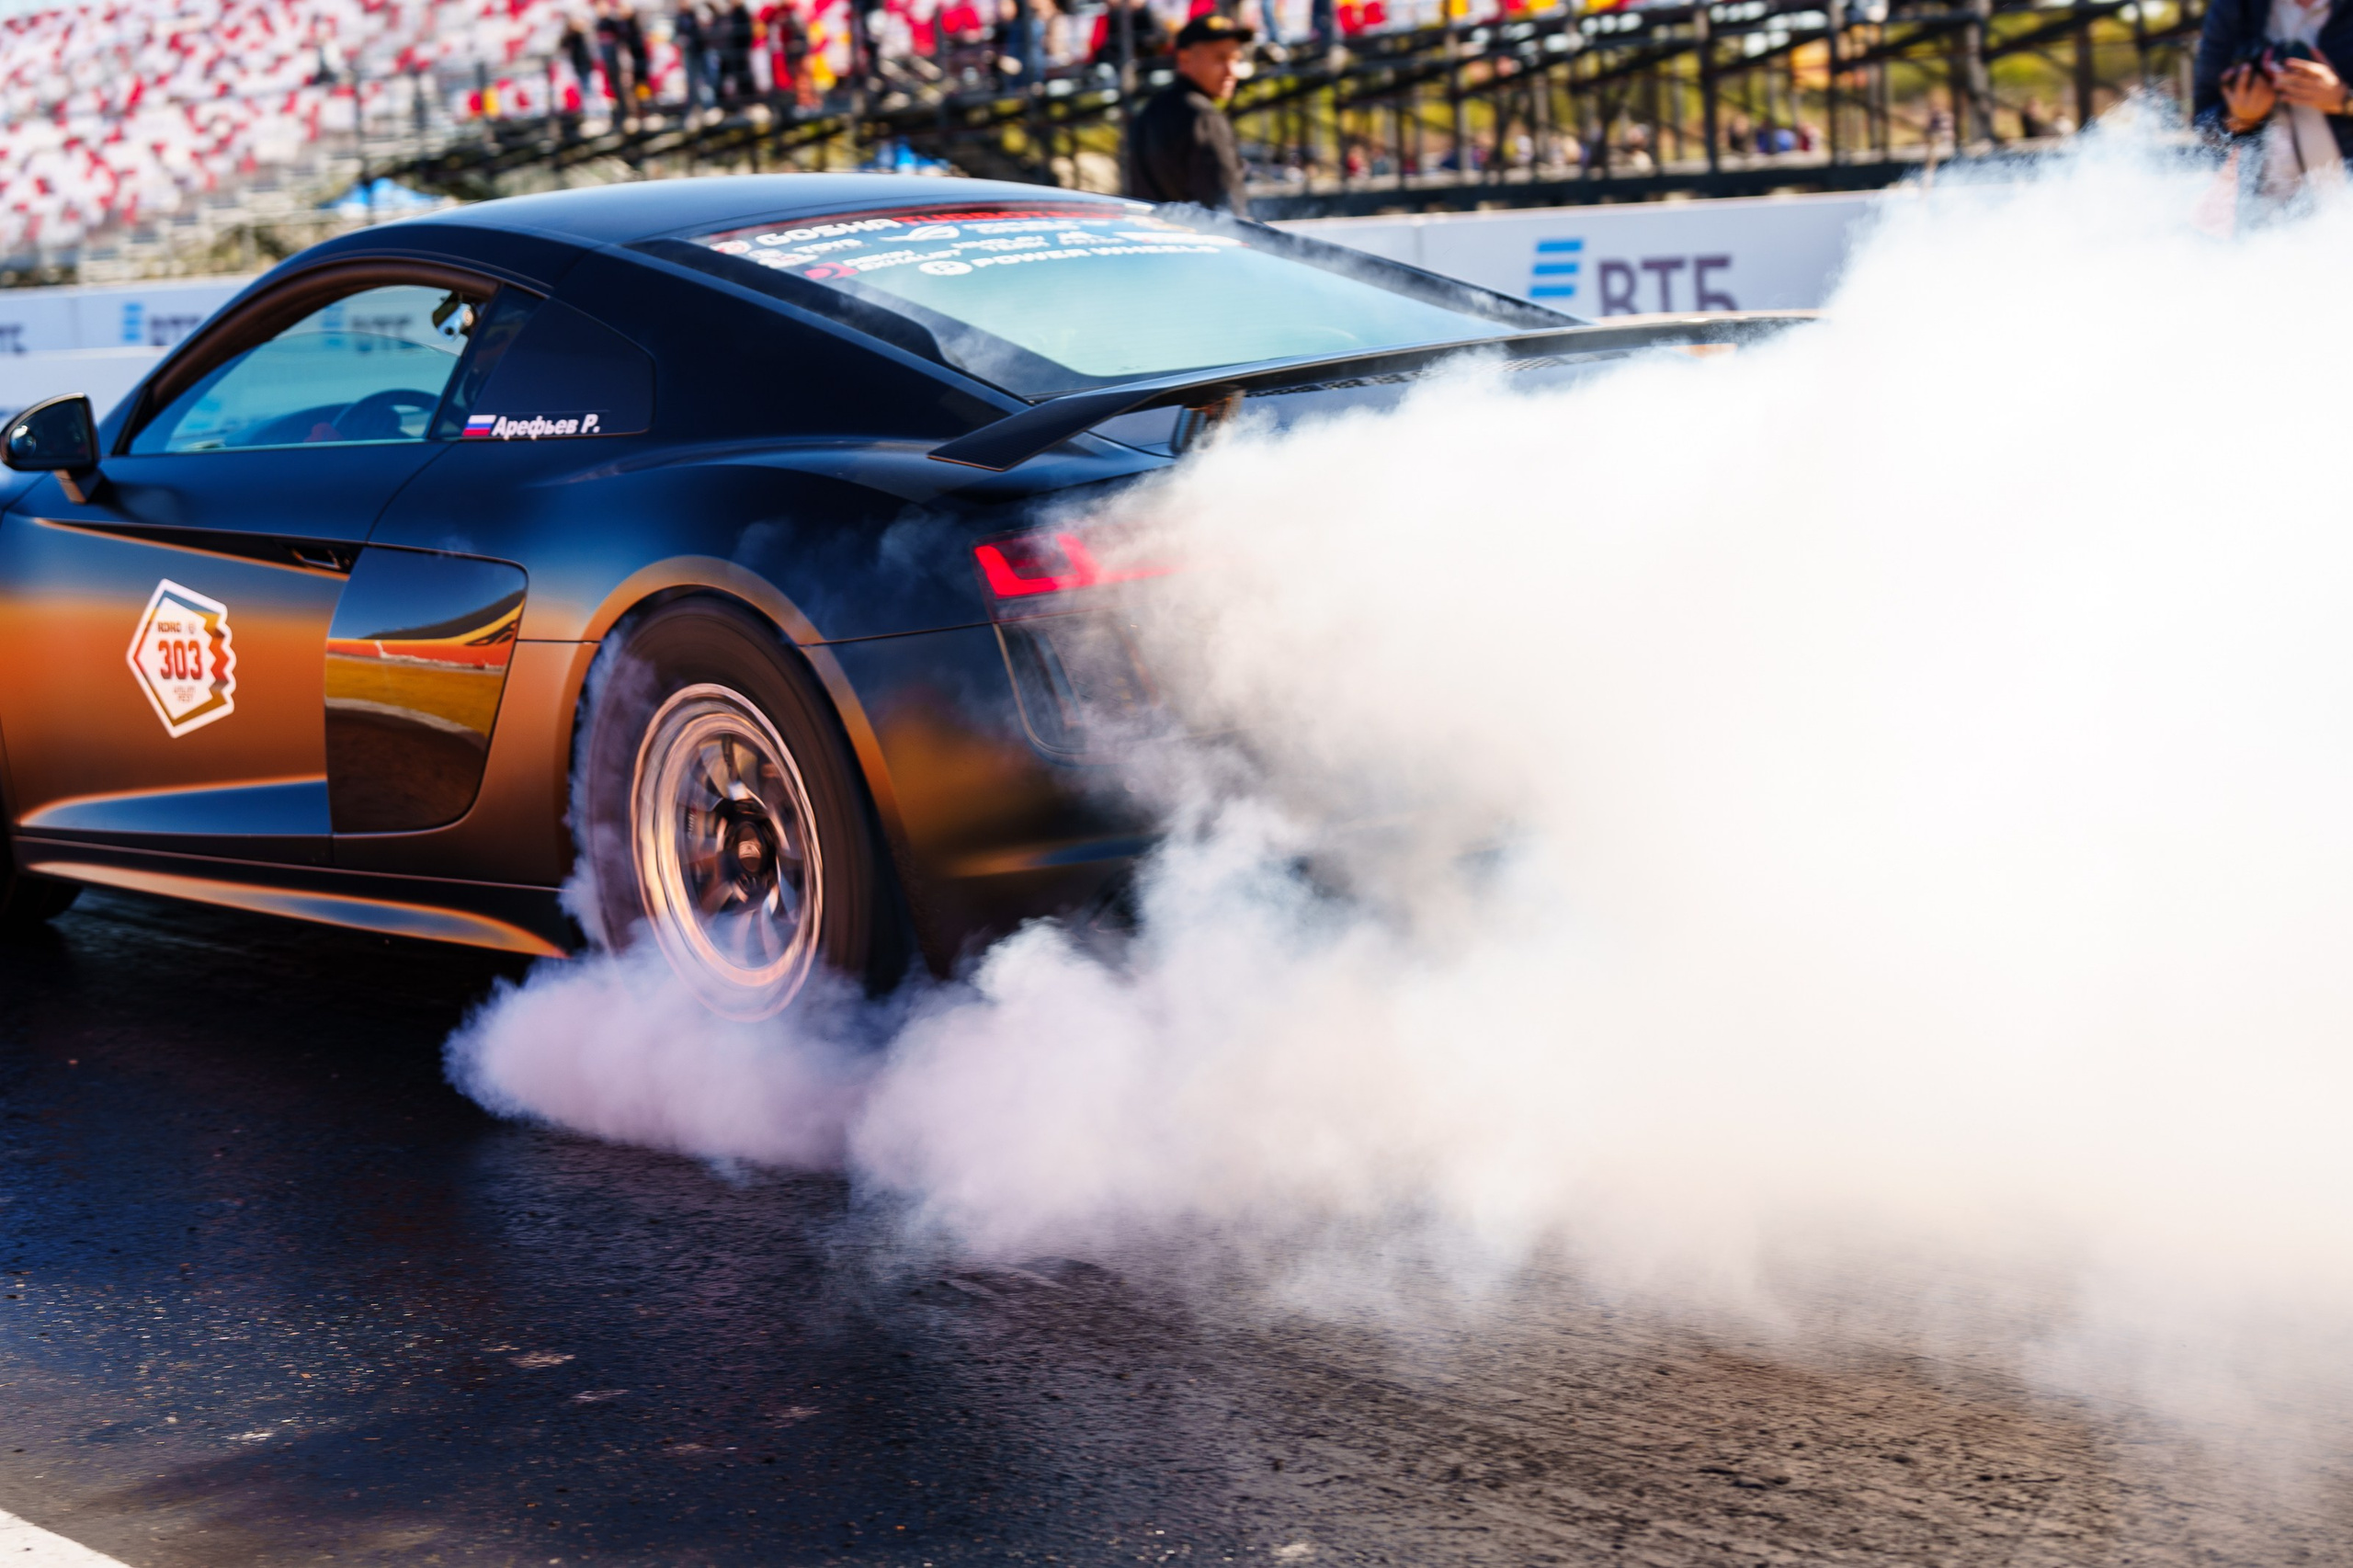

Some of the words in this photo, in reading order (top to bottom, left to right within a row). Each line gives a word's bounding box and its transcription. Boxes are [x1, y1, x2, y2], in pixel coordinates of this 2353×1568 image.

[970, 248, 1092, 267] POWER
[1597, 255, 1738, 317] ВТБ
[491, 415, 579, 440] Арефьев
[580, 413, 601, 434] Р.
[158, 639, 203, 680] 303
